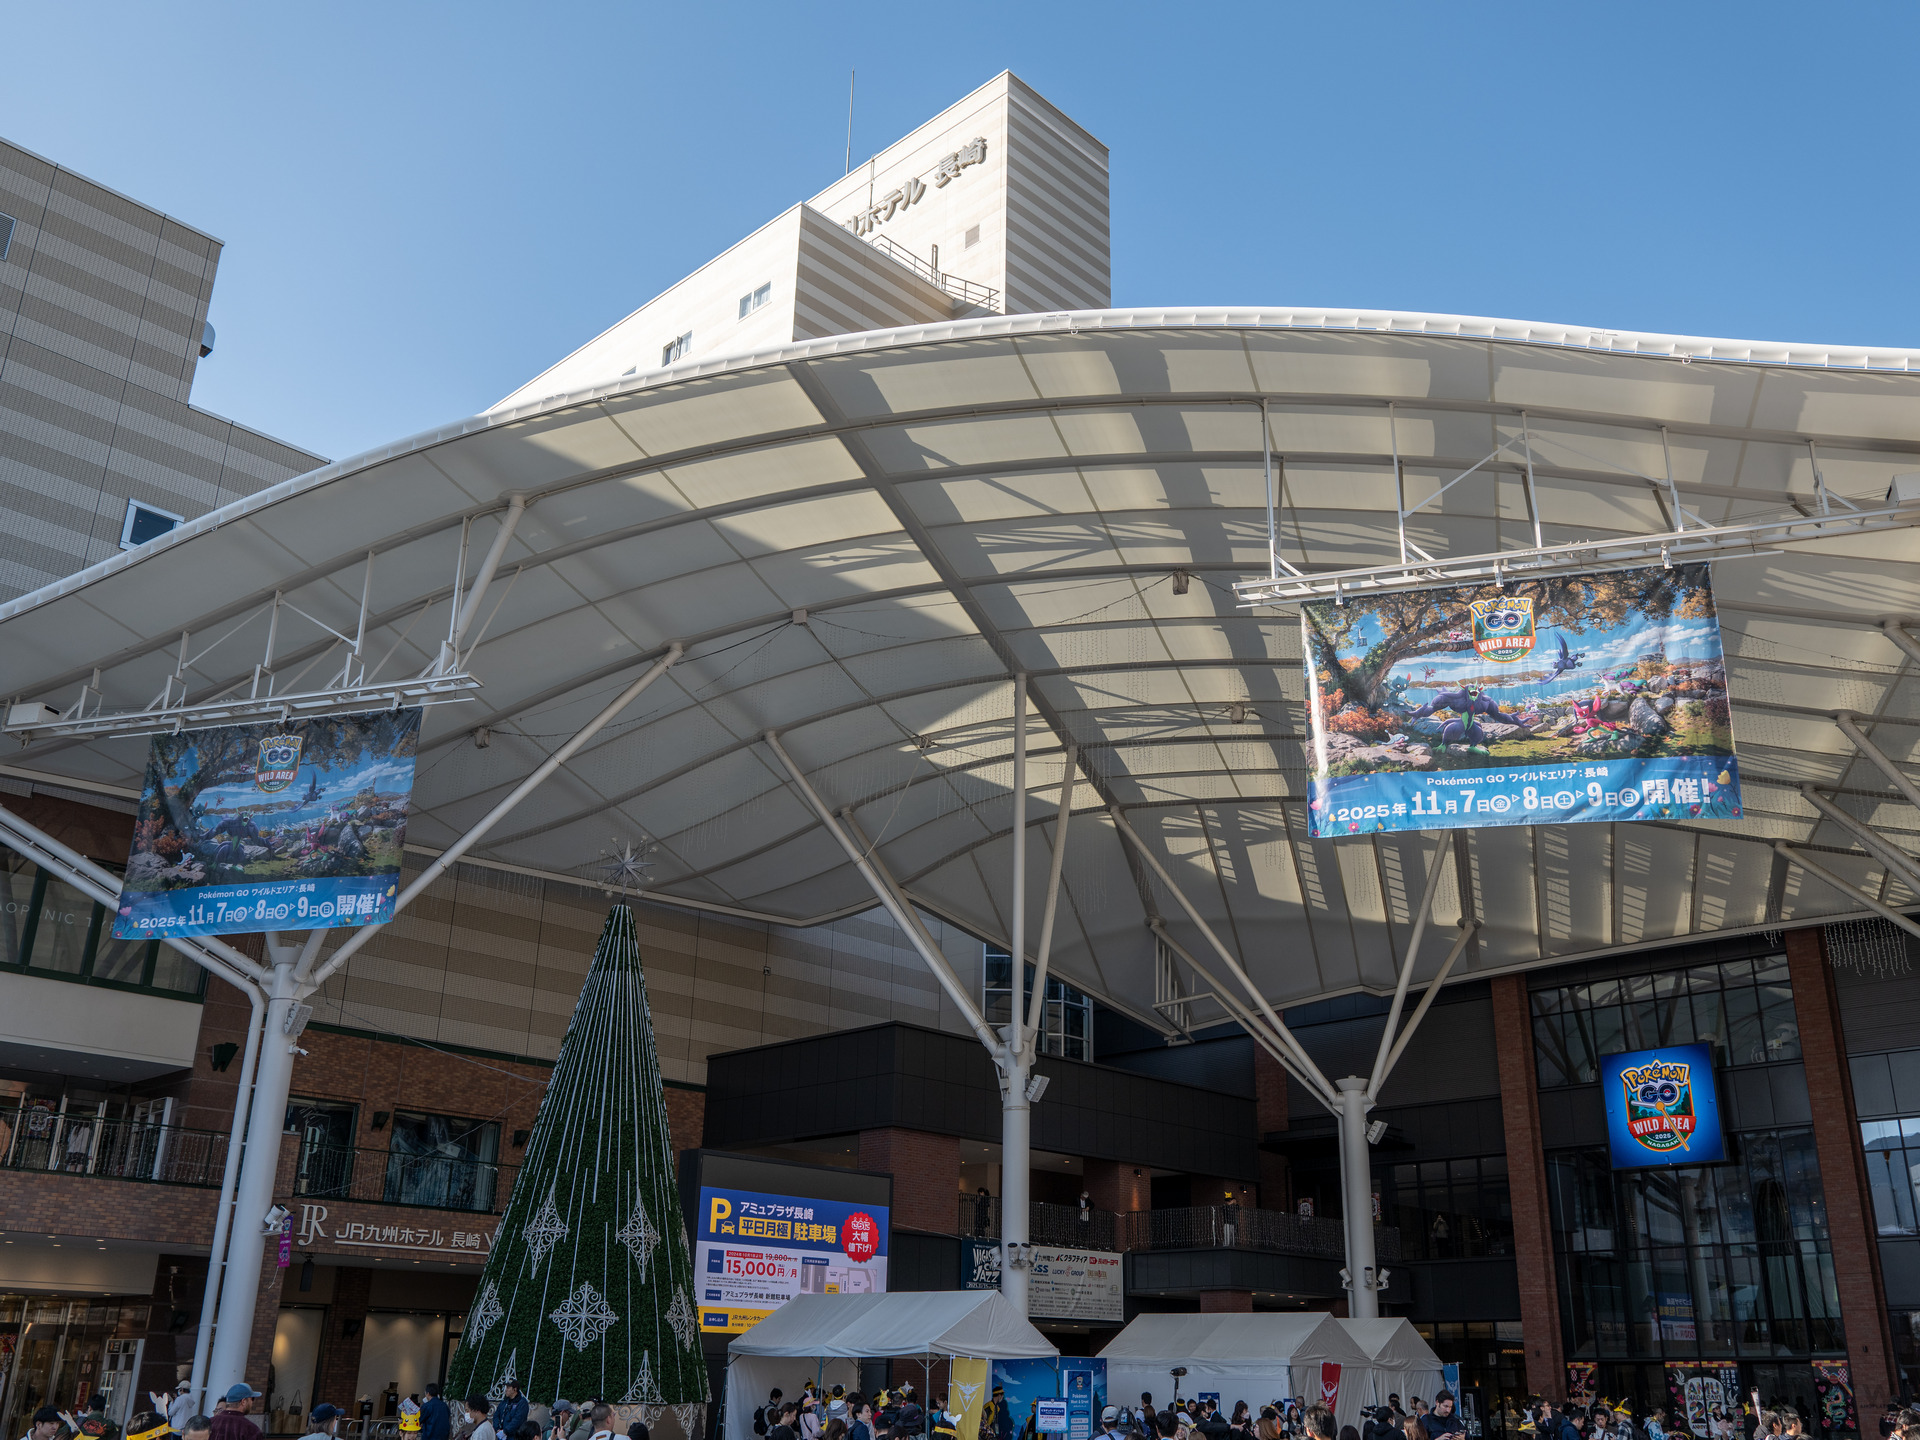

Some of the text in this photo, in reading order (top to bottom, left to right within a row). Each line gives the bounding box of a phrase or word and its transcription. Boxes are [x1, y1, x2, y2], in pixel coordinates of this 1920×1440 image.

[935, 136, 988, 188] 長崎
[1485, 612, 1521, 629] GO
[1478, 637, 1530, 652] WILD AREA
[268, 749, 293, 764] GO
[258, 771, 294, 782] WILD AREA
[1427, 775, 1483, 786] Pokémon
[1486, 774, 1505, 784] GO
[198, 892, 234, 900] Pokémon
[236, 889, 249, 897] GO
[1640, 1083, 1678, 1105] GO
[1633, 1118, 1659, 1134] WILD
[1646, 1139, 1679, 1148] NAGASAK
[709, 1196, 732, 1233] P
[740, 1200, 814, 1221] アミュプラザ長崎
[335, 1222, 444, 1247] JR九州ホテル
[451, 1231, 481, 1250] 長崎
[741, 1217, 837, 1244] 平日月極 駐車場
[852, 1231, 869, 1243] 大幅
[972, 1265, 1000, 1283] JAZZ
[1688, 1381, 1720, 1394] AMU
